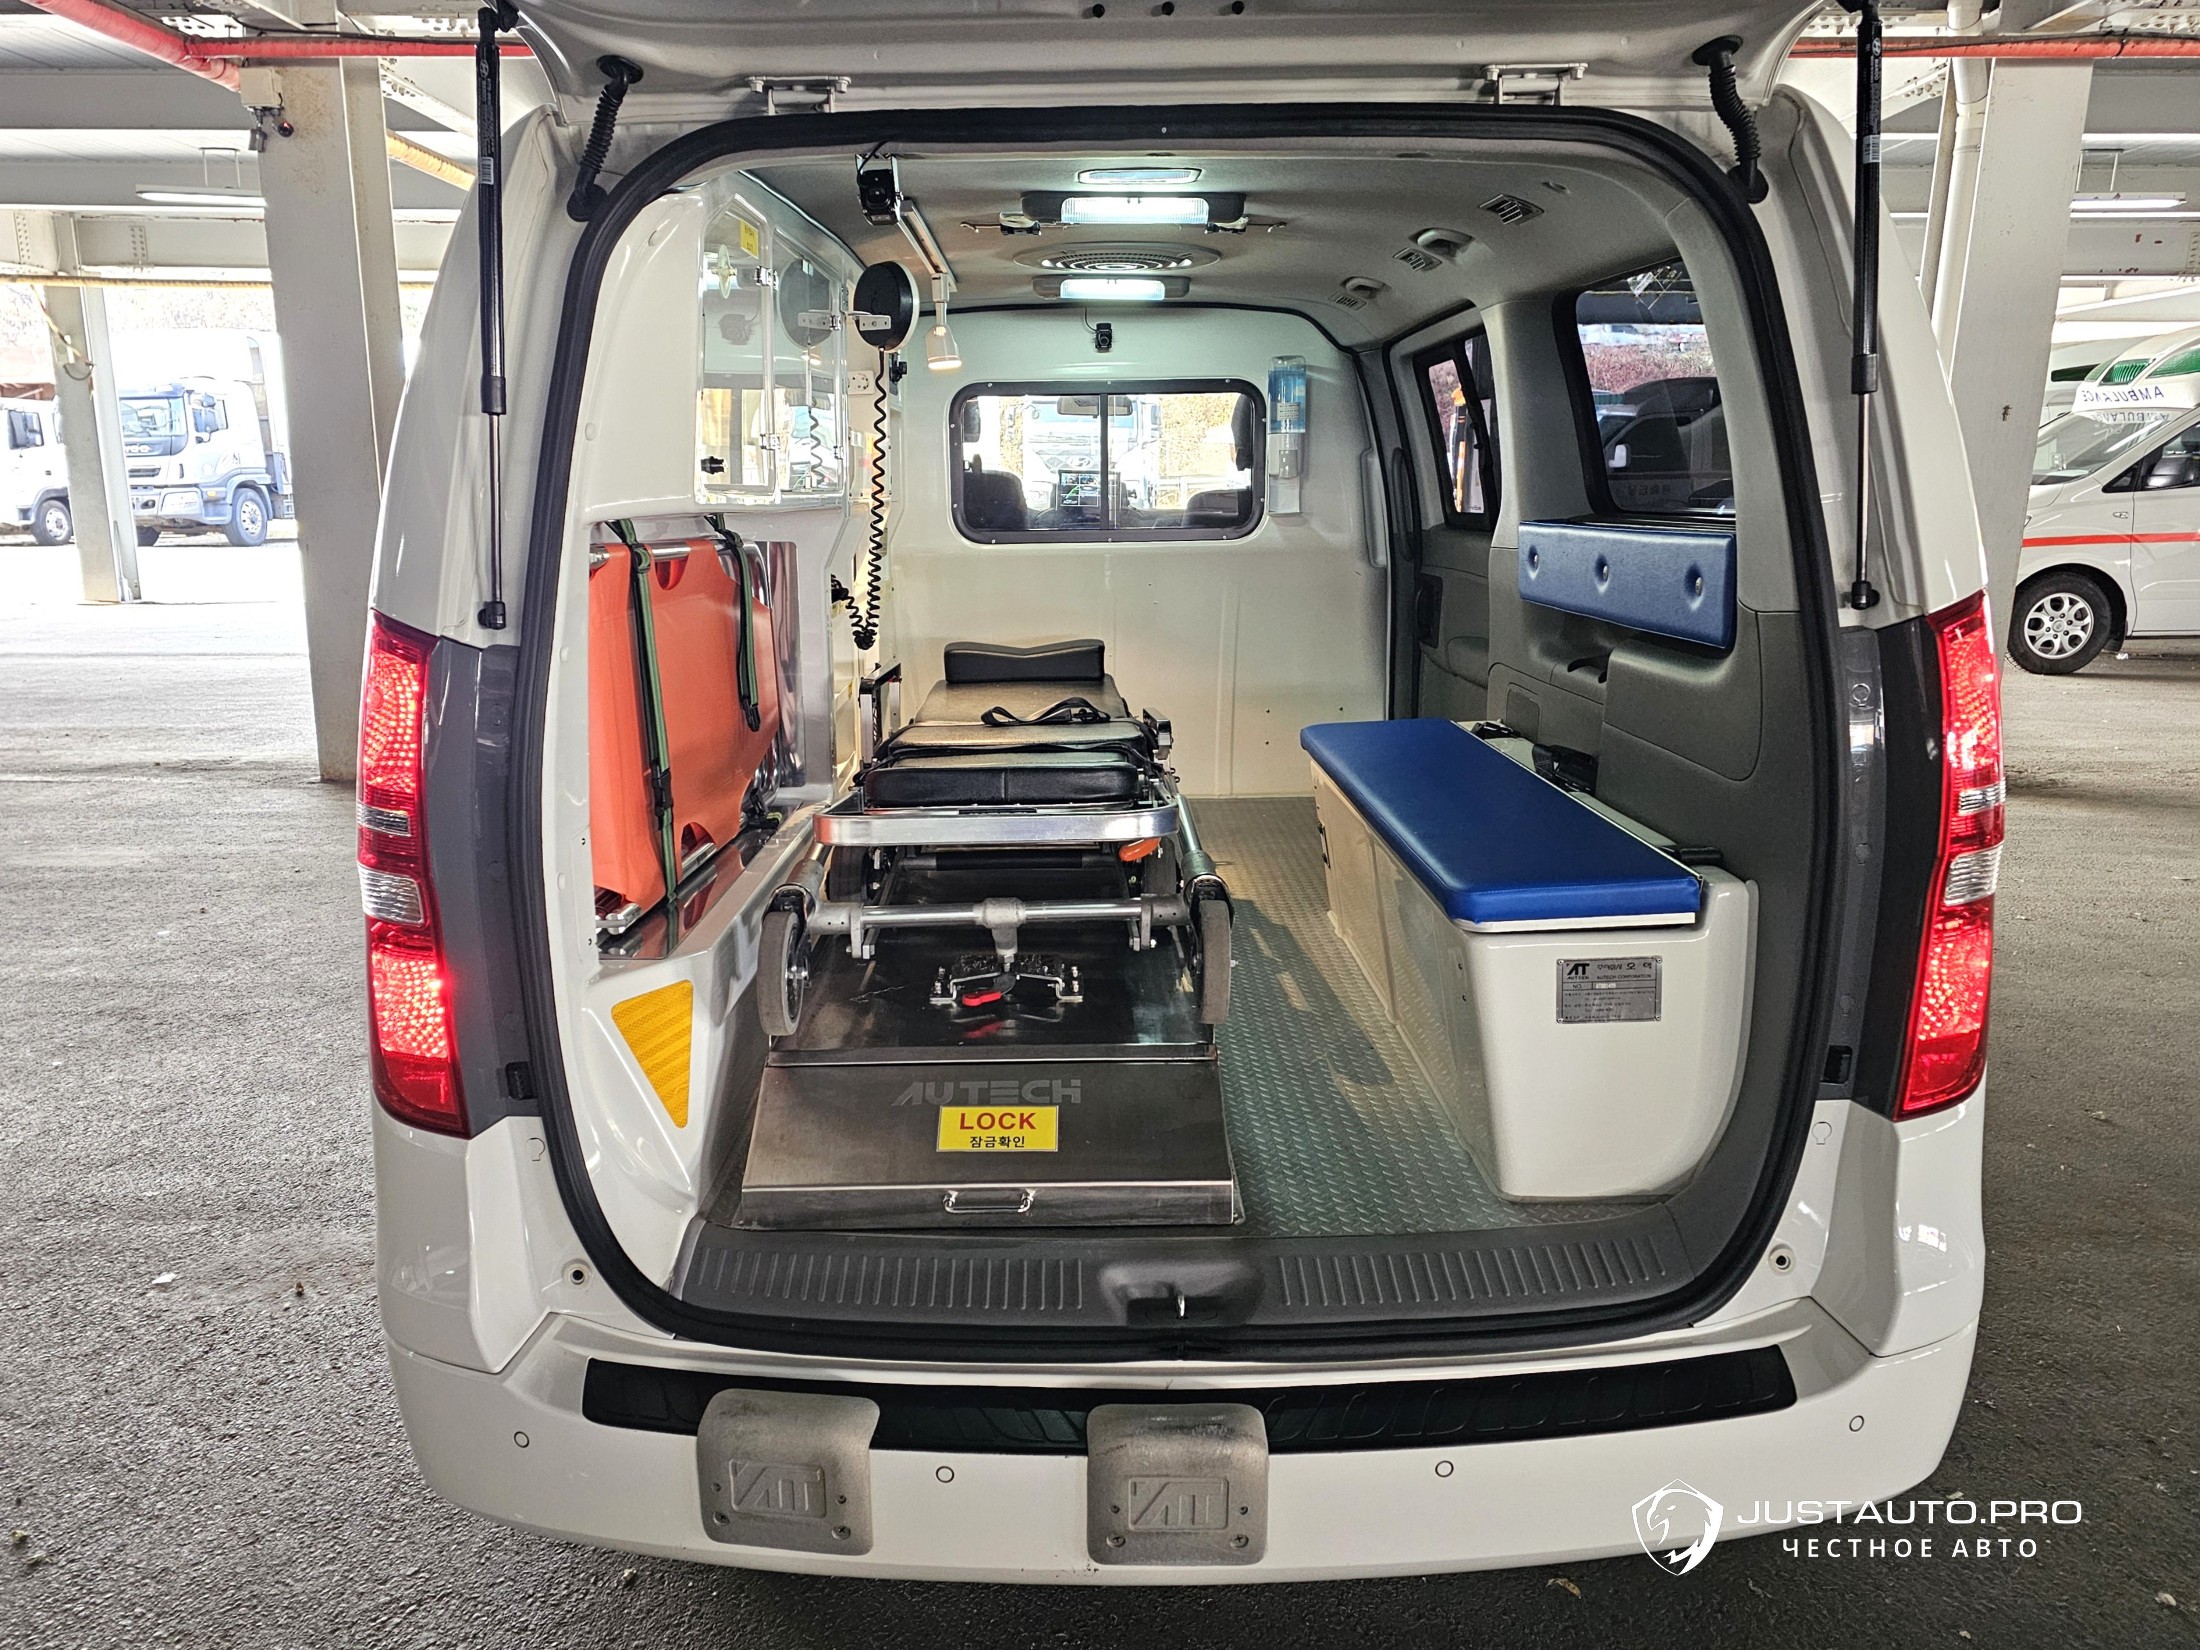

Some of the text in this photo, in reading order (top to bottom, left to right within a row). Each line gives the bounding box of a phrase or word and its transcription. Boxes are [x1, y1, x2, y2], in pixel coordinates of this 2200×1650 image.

[891, 1079, 1082, 1107] AUTECH
[959, 1112, 1037, 1130] LOCK
[970, 1136, 1025, 1148] 잠금확인
